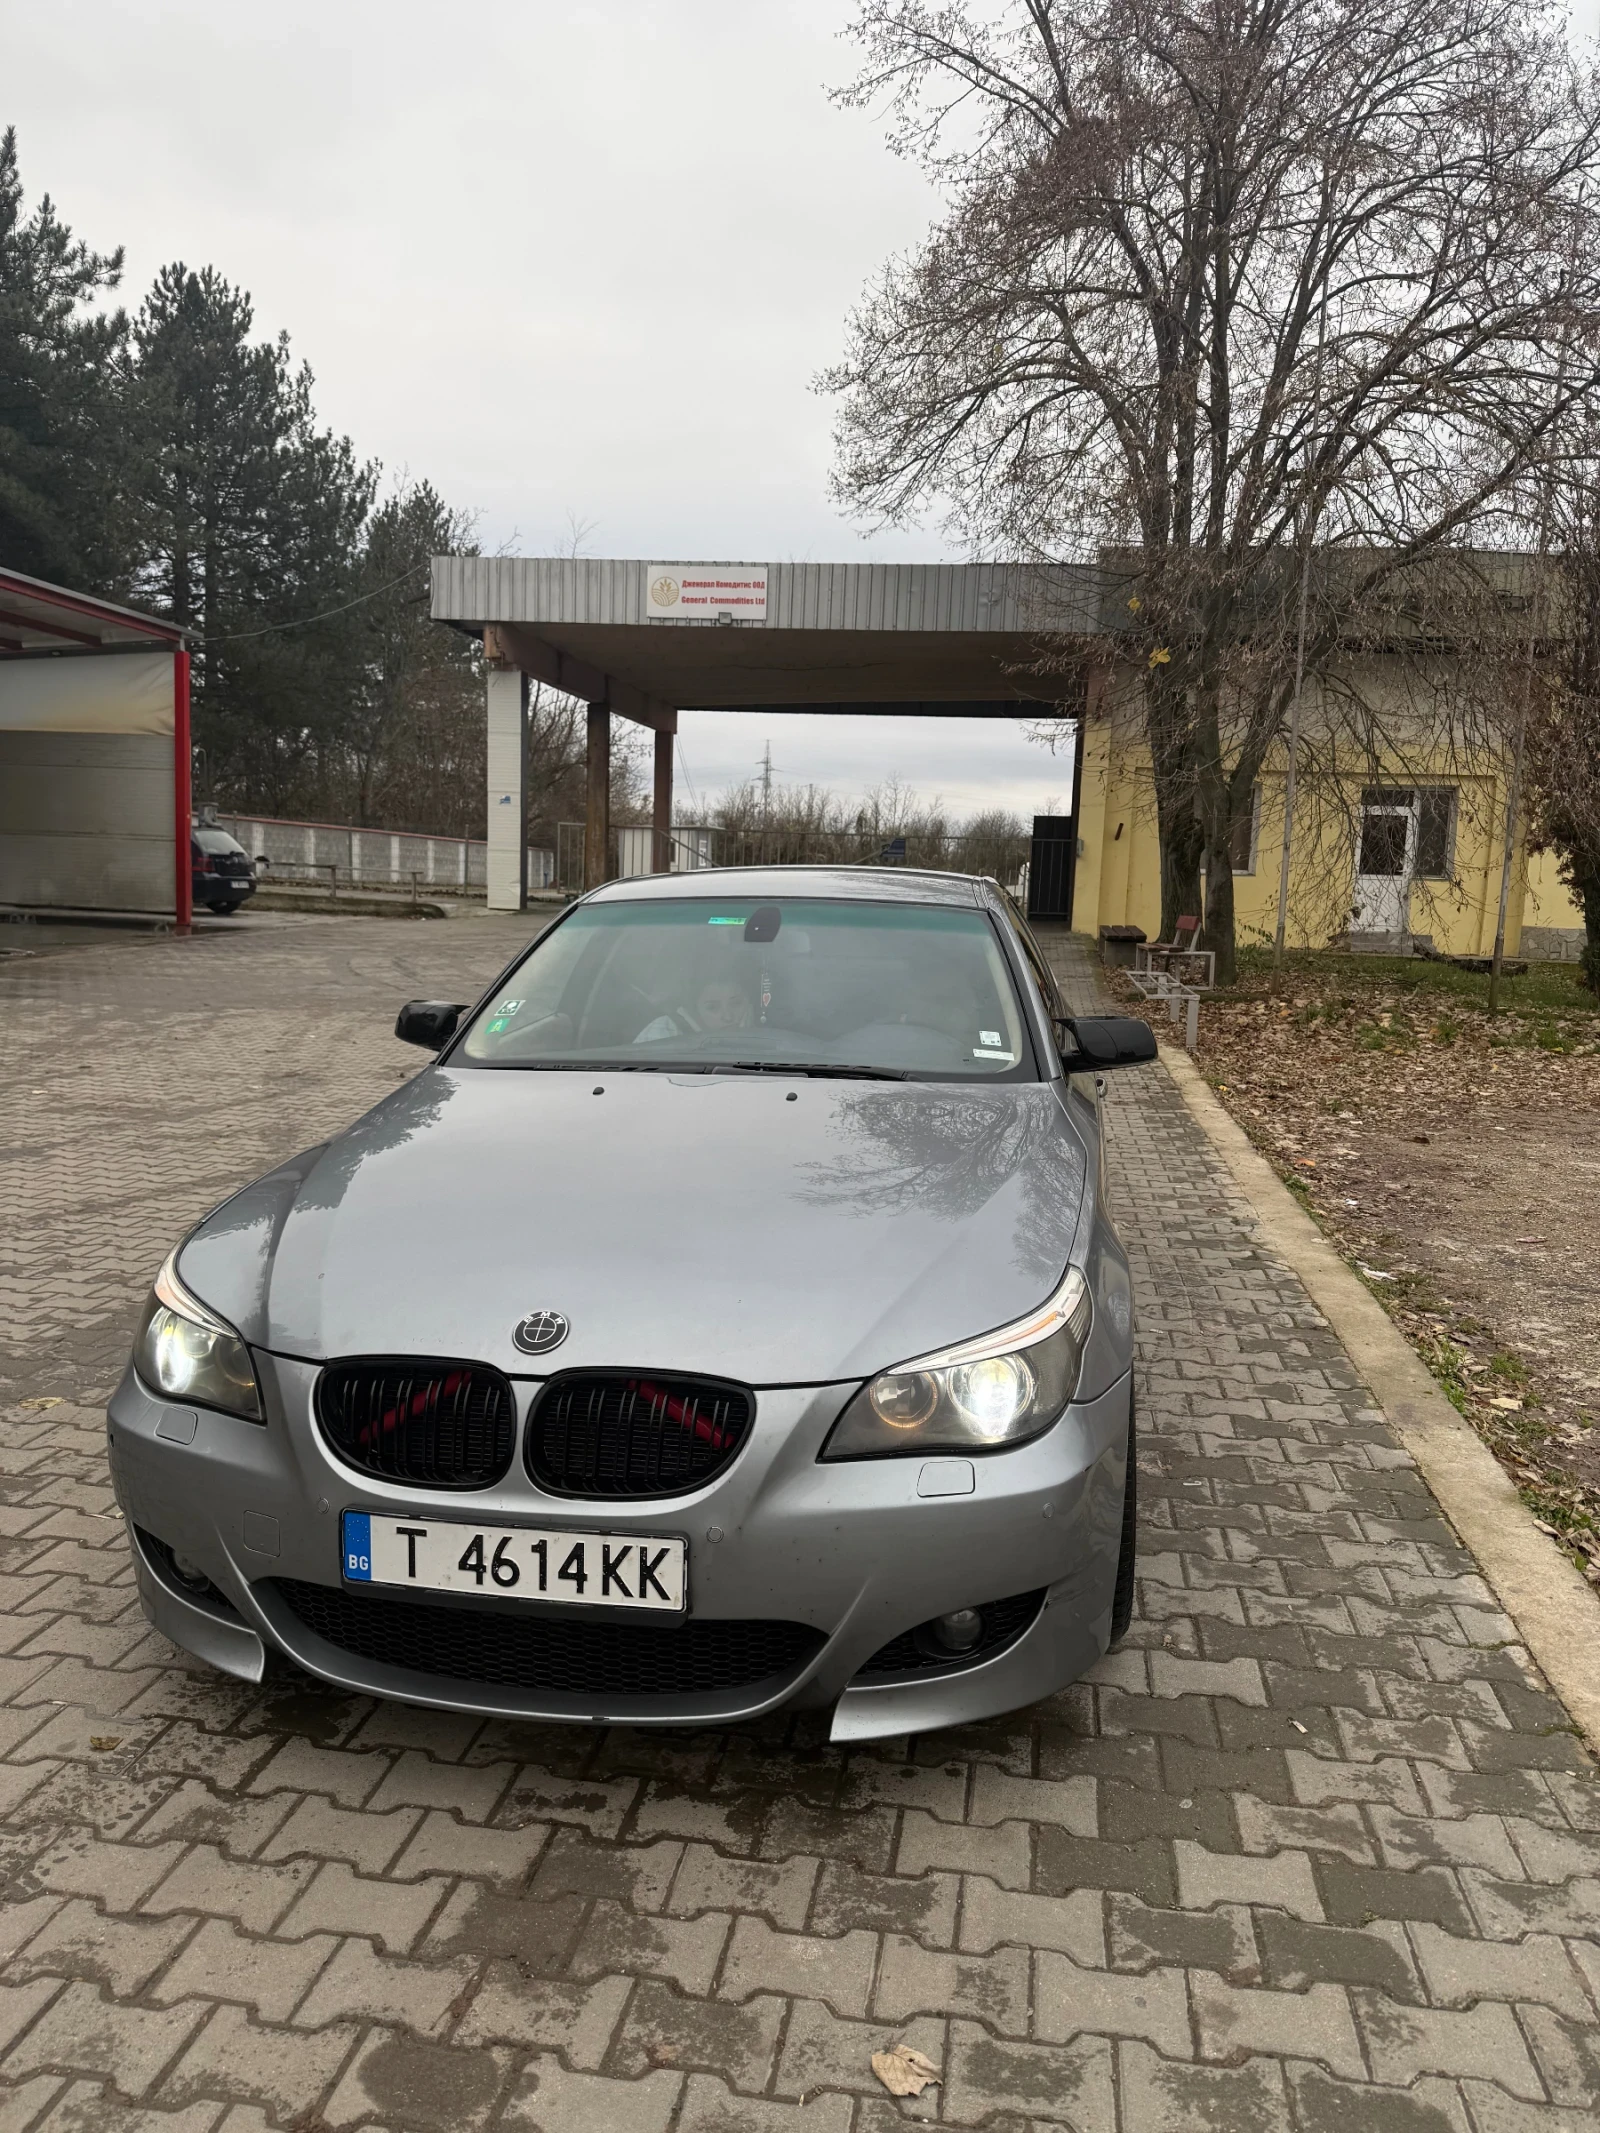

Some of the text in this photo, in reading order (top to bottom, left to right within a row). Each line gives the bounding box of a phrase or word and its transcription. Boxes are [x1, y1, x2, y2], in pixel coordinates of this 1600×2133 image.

[682, 580, 765, 589] Дженерал Комодитис ООД
[681, 596, 765, 605] General Commodities Ltd
[524, 1311, 564, 1324] BMW
[396, 1526, 427, 1578] T
[348, 1554, 369, 1571] BG
